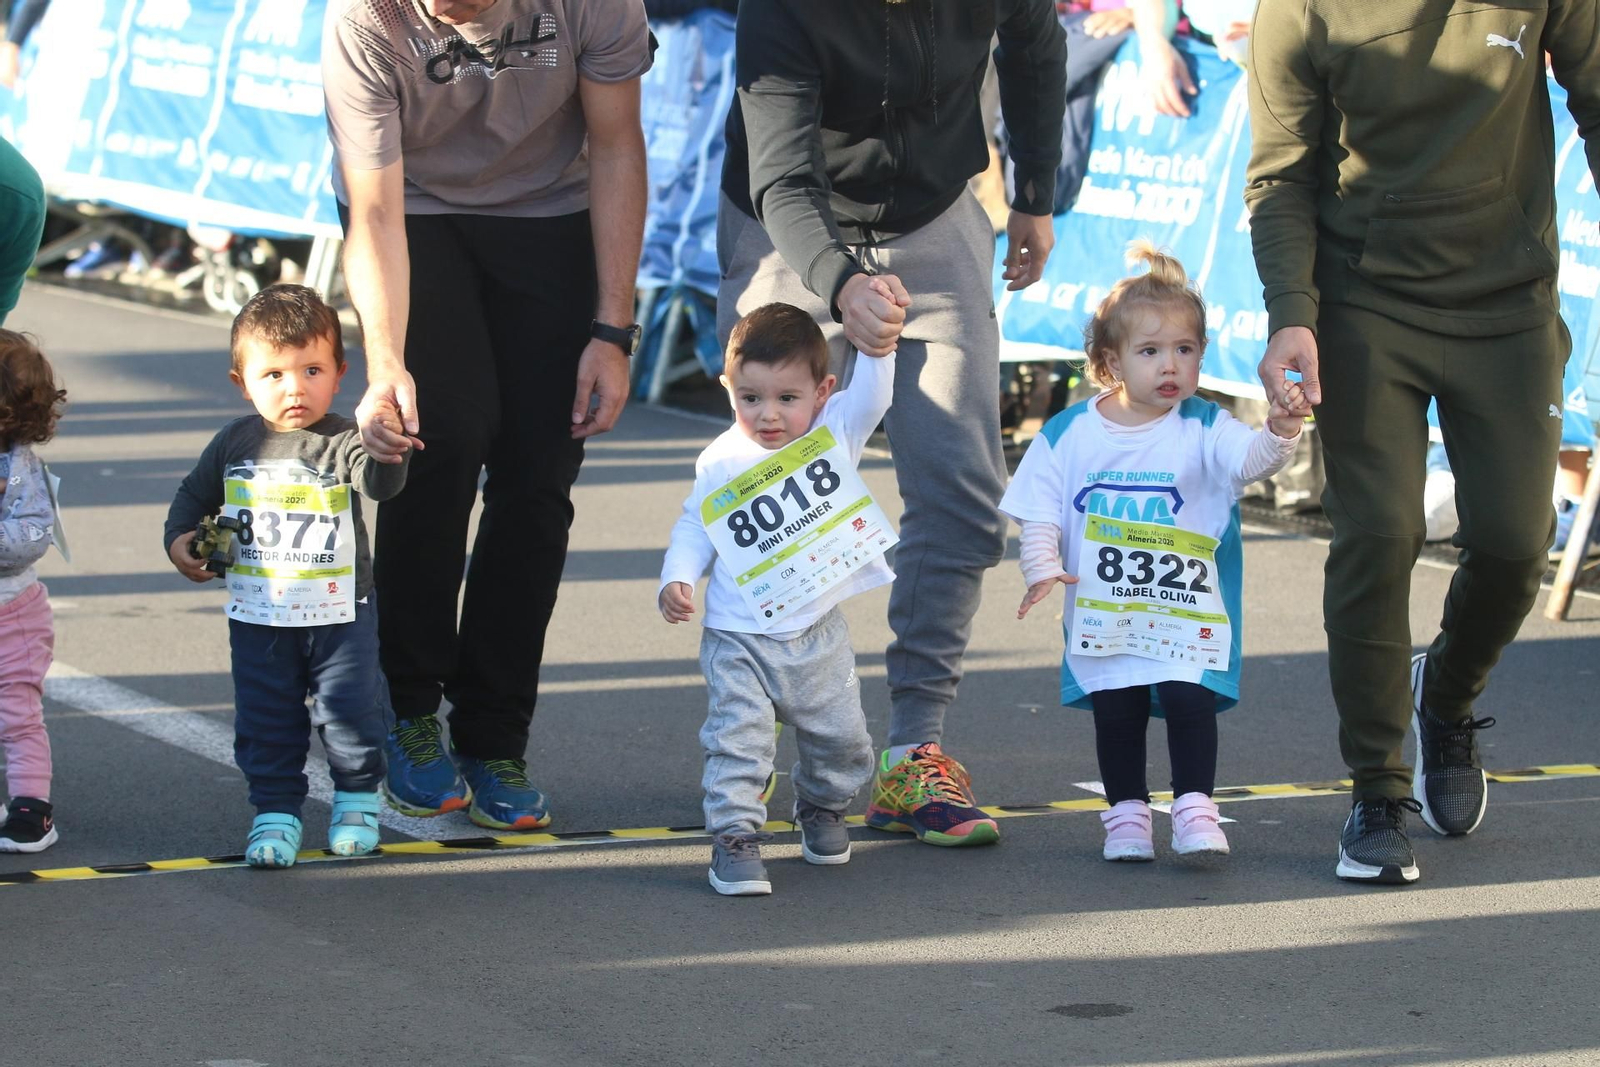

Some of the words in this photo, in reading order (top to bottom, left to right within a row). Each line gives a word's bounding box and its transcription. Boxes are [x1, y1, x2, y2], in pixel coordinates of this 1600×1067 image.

[753, 459, 781, 478] Maratón
[1086, 471, 1124, 483] SUPER
[1125, 471, 1175, 483] RUNNER
[740, 477, 765, 497] Almería
[764, 465, 784, 482] 2020
[285, 496, 306, 505] 2020
[727, 458, 841, 548] 8018
[237, 508, 341, 551] 8377
[757, 532, 784, 554] MINI
[783, 501, 833, 538] RUNNER
[1127, 527, 1149, 536] Medio
[1127, 534, 1157, 544] Almería
[1157, 537, 1175, 547] 2020
[241, 547, 280, 562] HECTOR
[283, 551, 335, 564] ANDRES
[1096, 546, 1213, 594] 8322
[752, 582, 771, 598] NEXA
[1111, 586, 1156, 598] ISABEL
[1160, 590, 1198, 605] OLIVA
[1082, 617, 1103, 628] NEXA
